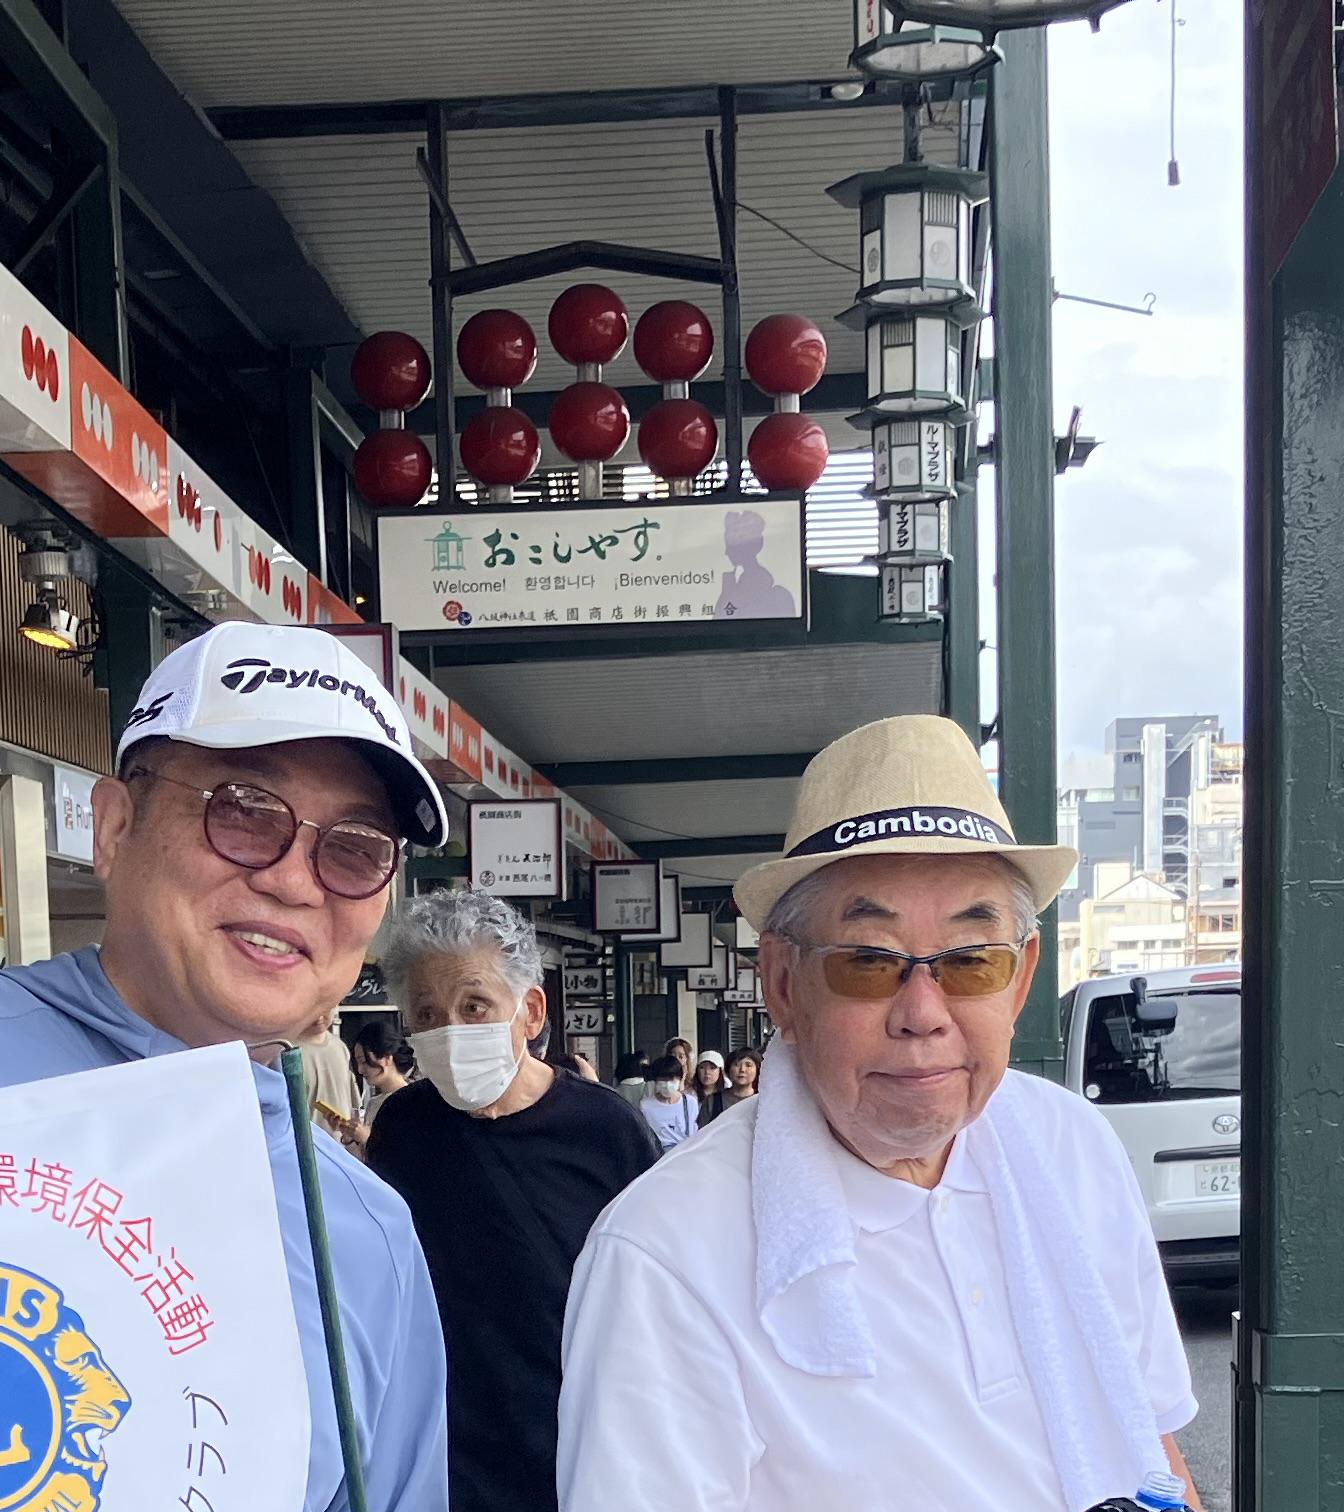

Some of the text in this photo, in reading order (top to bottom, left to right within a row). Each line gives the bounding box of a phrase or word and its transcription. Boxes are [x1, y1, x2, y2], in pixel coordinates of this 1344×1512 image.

[433, 578, 506, 593] Welcome!
[614, 570, 714, 590] ¡Bienvenidos!
[834, 810, 999, 845] Cambodia
